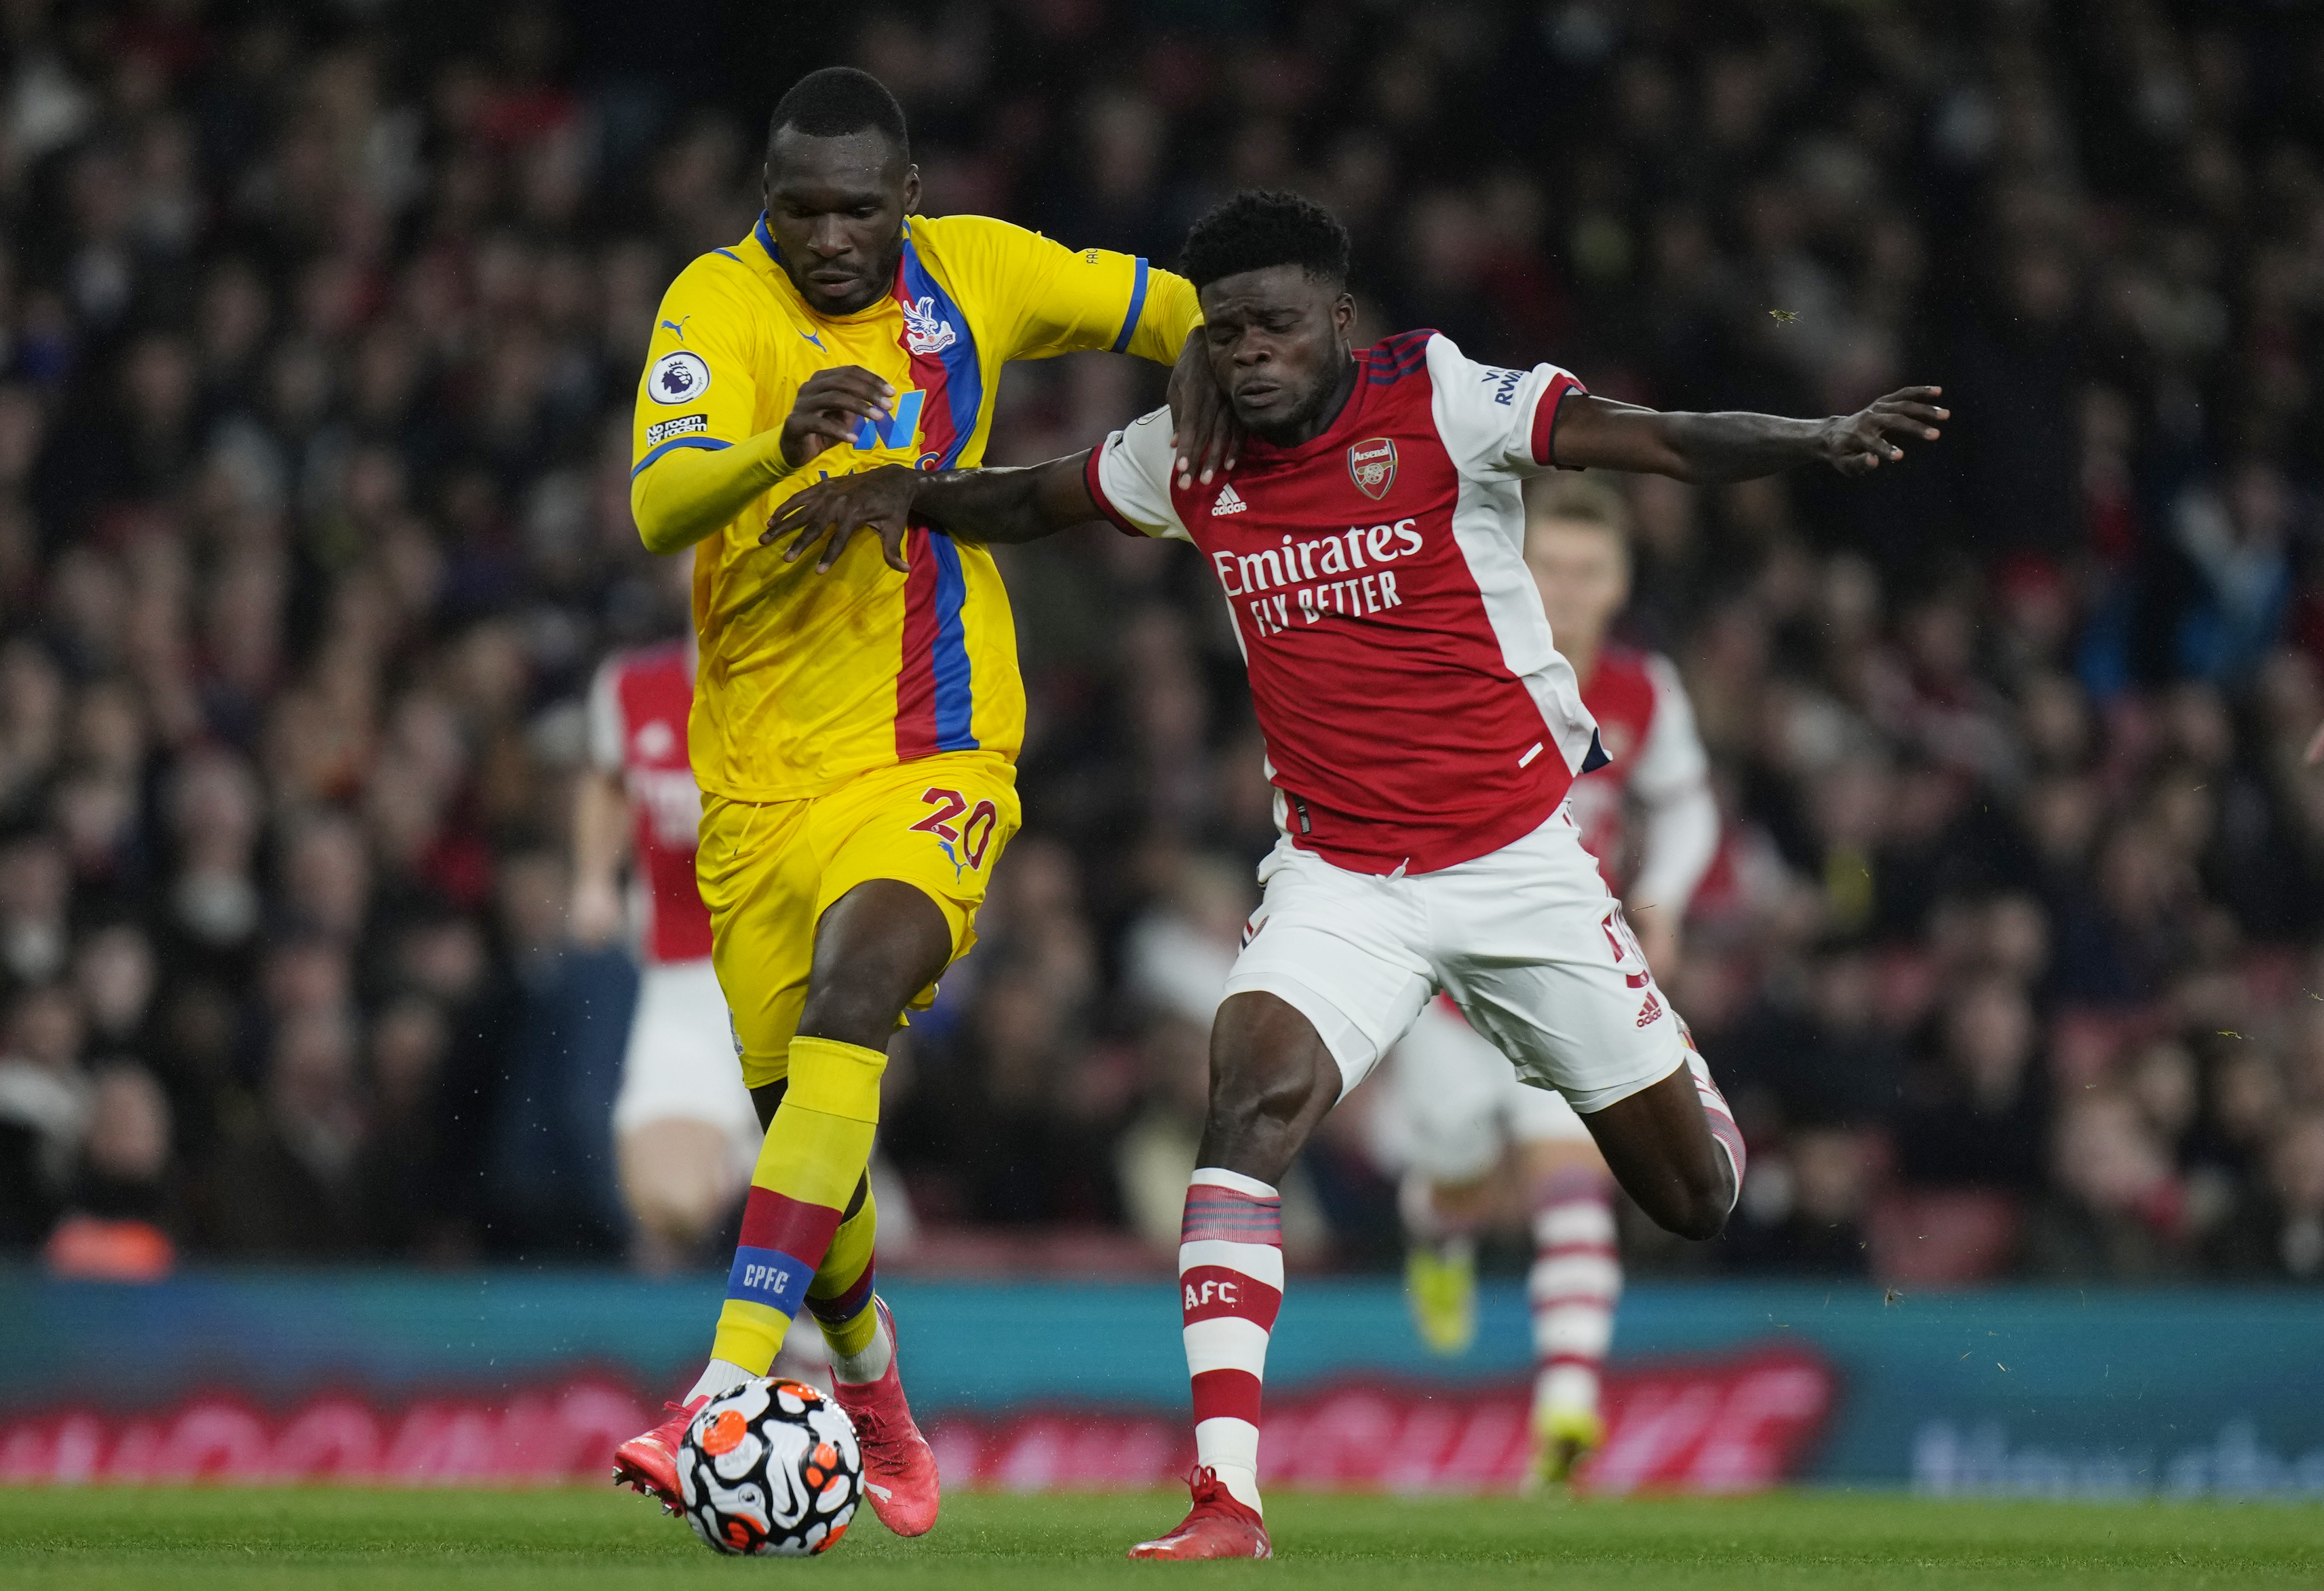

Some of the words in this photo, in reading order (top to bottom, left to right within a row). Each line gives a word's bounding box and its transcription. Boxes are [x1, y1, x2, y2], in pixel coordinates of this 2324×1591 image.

[646, 424, 663, 438] No
[665, 415, 701, 431] room
[647, 433, 664, 448] for
[664, 423, 708, 438] racism
[1354, 446, 1389, 462] Arsenal
[1212, 501, 1247, 516] adidas
[1212, 518, 1423, 597] Emirates
[1250, 594, 1290, 637] FLY
[1298, 571, 1403, 624] BETTER
[907, 786, 998, 872] 20
[743, 1263, 790, 1295] CPFC
[1185, 1280, 1238, 1310] AFC
